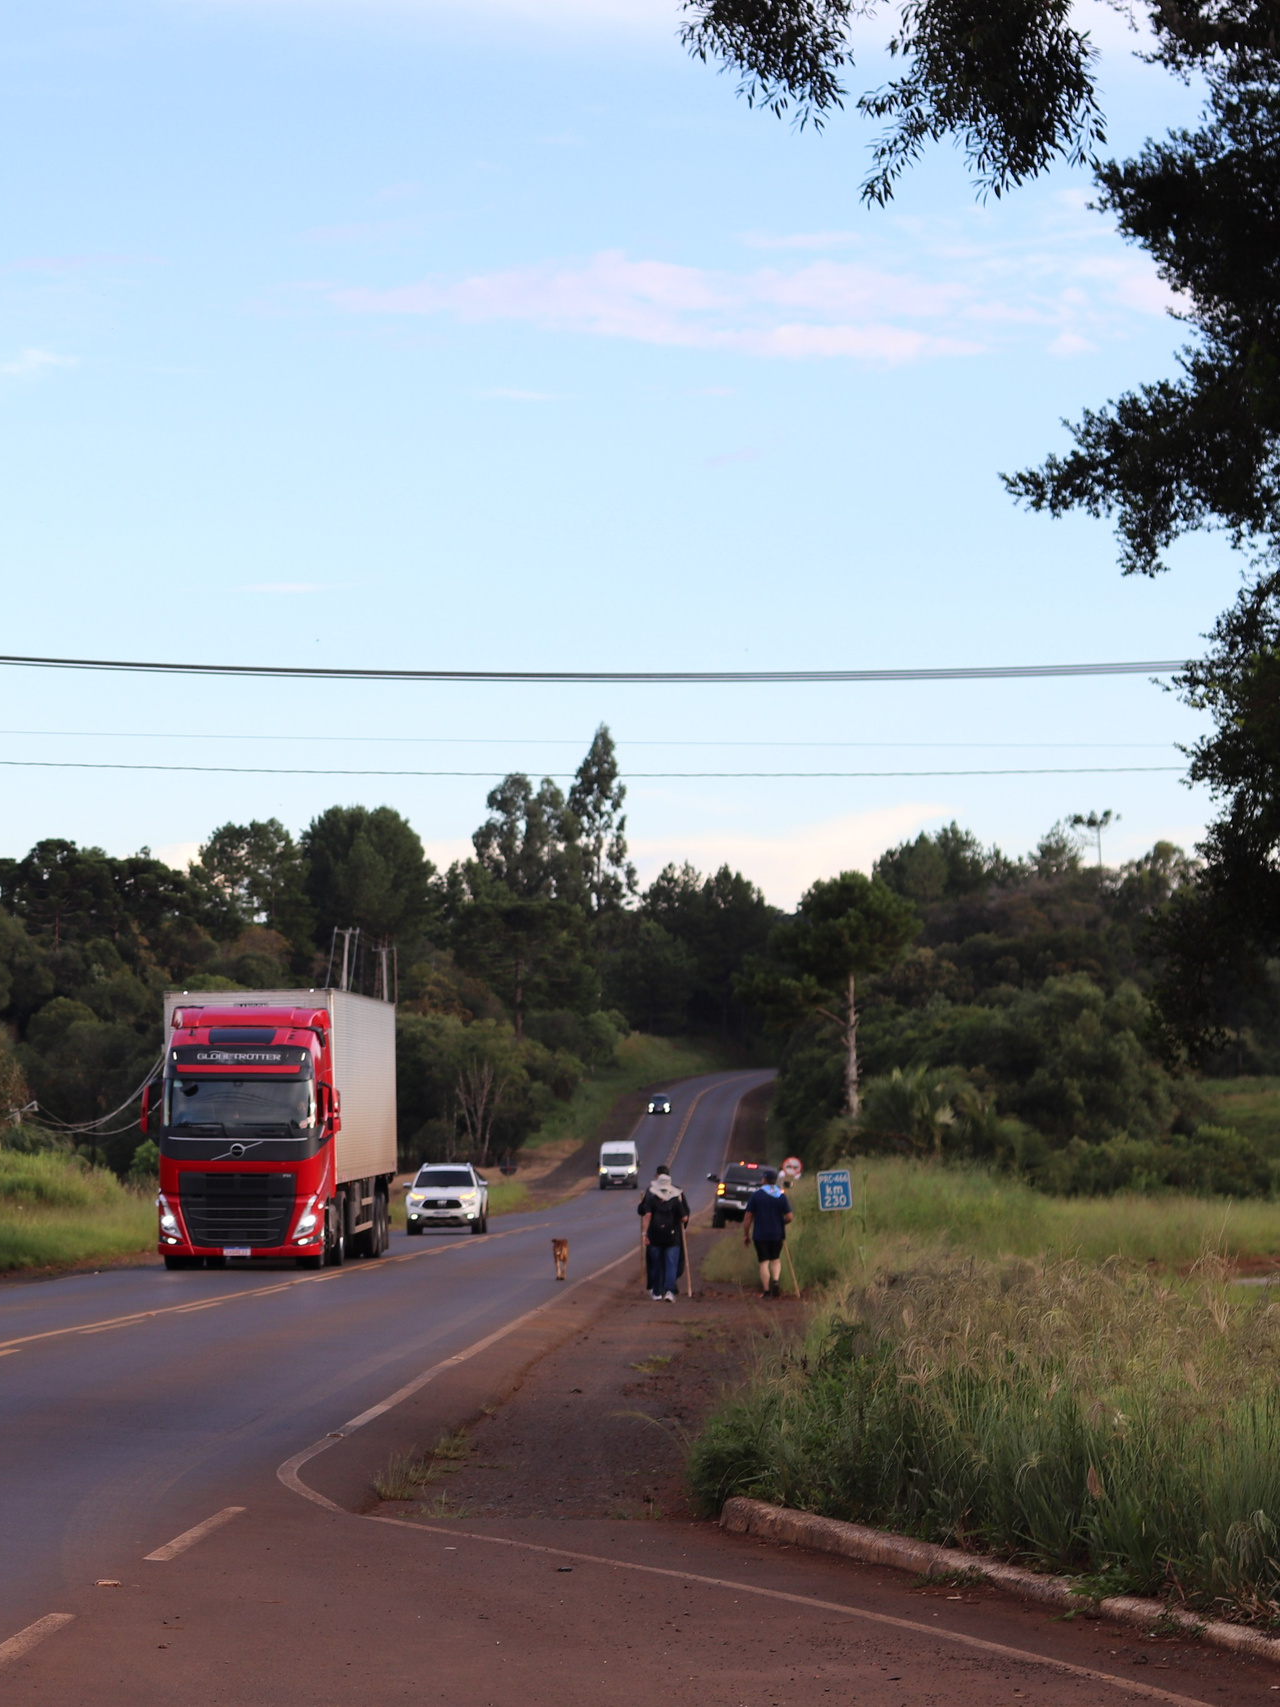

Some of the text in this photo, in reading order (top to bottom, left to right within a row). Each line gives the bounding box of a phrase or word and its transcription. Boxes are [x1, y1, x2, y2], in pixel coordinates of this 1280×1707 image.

[196, 1052, 281, 1061] GLOBETROTTER
[826, 1184, 843, 1195] km
[824, 1194, 847, 1207] 230
